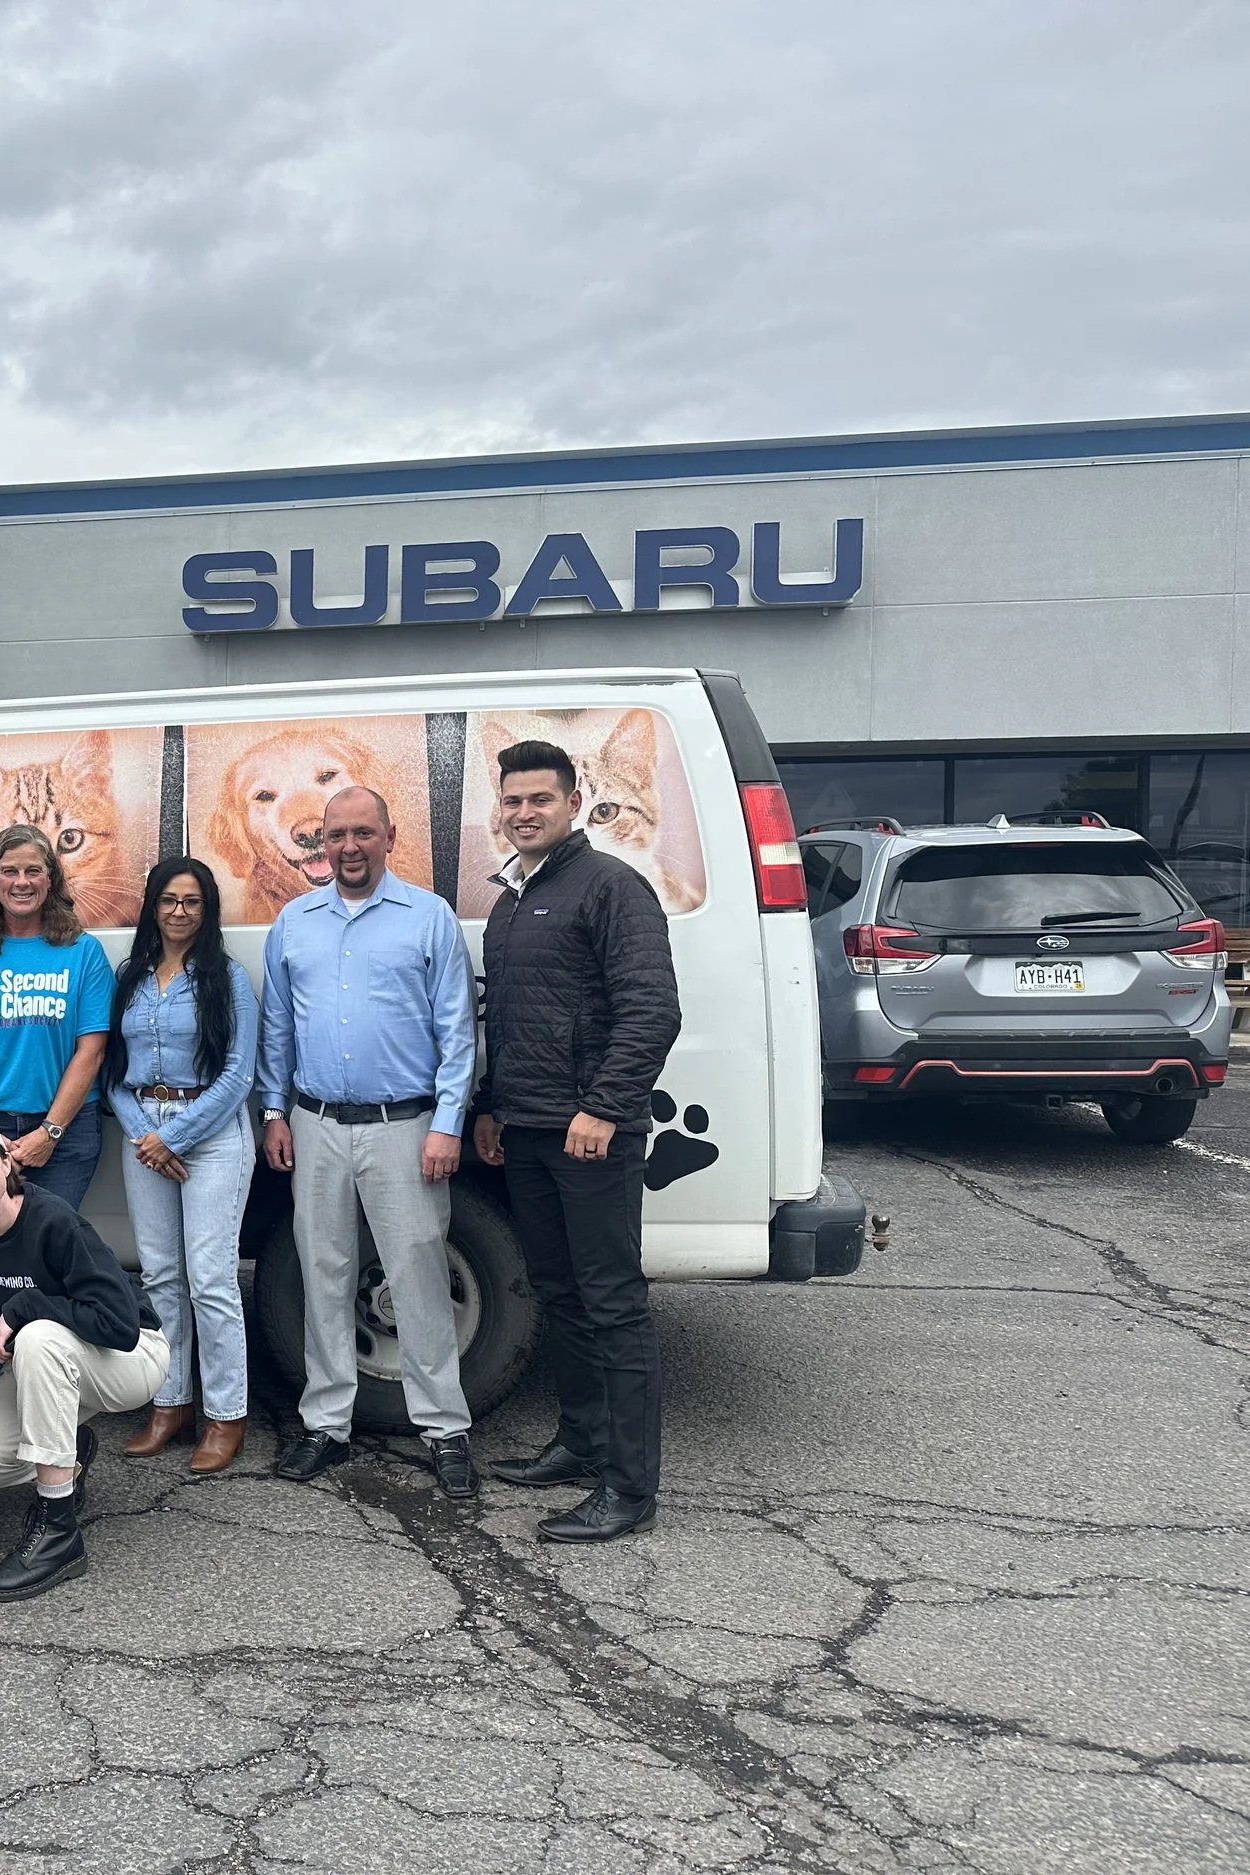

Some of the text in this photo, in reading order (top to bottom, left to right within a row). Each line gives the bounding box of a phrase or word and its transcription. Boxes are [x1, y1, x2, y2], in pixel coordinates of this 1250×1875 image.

[182, 518, 864, 632] SUBARU
[0, 968, 69, 993] Second
[1, 992, 66, 1019] Chance
[24, 1276, 37, 1288] CO.
